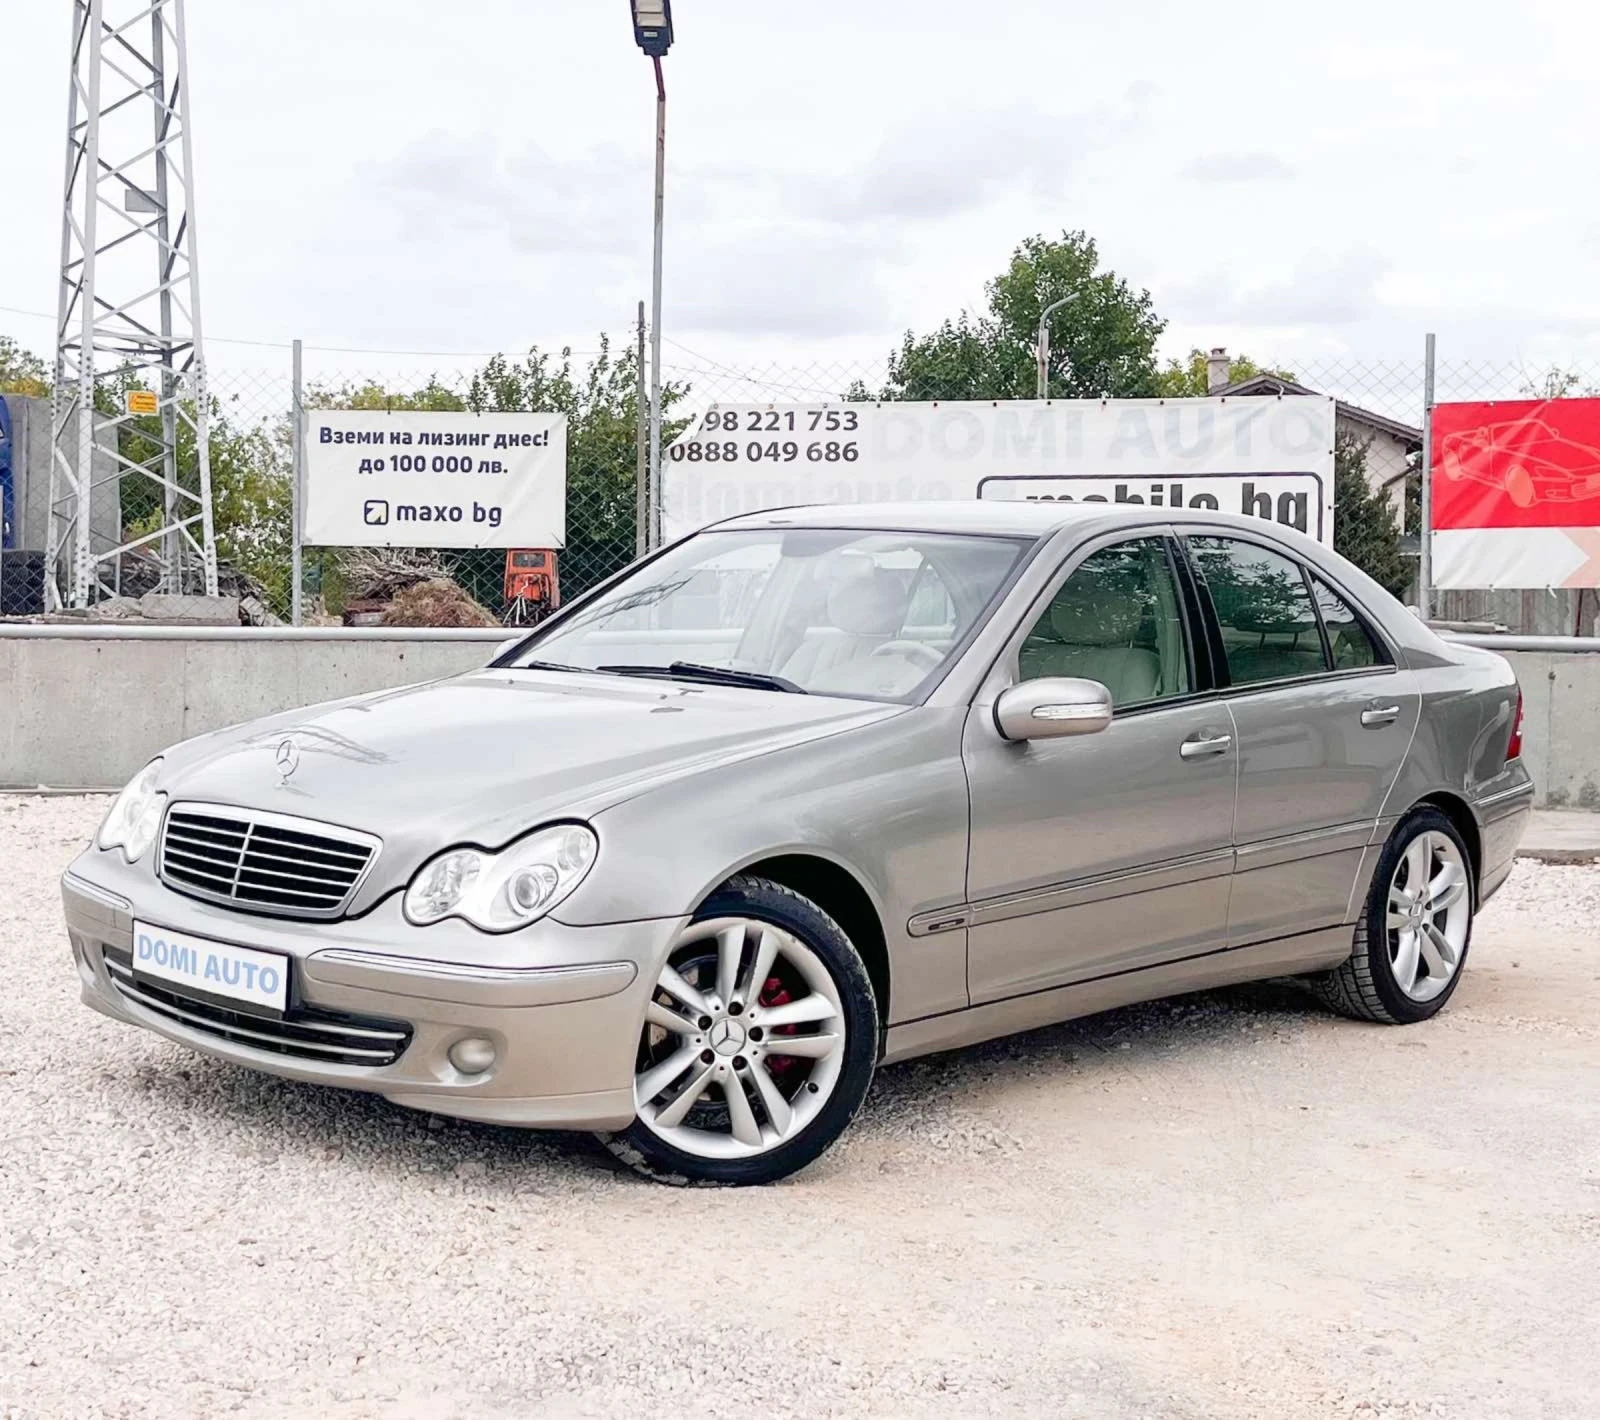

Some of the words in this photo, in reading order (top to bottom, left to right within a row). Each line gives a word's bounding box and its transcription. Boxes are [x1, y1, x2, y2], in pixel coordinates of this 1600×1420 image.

[698, 411, 739, 431] 98
[747, 411, 796, 431] 221
[807, 411, 859, 431] 753
[320, 427, 384, 445] Вземи
[390, 431, 412, 446] на
[418, 431, 490, 447] лизинг
[493, 430, 549, 449] днес!
[872, 408, 1084, 461] DOMI
[1106, 404, 1321, 459] AUTO
[670, 442, 738, 462] 0888
[747, 442, 798, 462] 049
[806, 442, 859, 462] 686
[359, 458, 385, 474] до
[390, 455, 426, 473] 100
[432, 455, 473, 474] 000
[478, 460, 508, 474] лв.
[396, 504, 463, 522] maxo
[473, 501, 502, 527] bg
[138, 934, 197, 976] DOMI
[204, 954, 279, 994] AUTO
